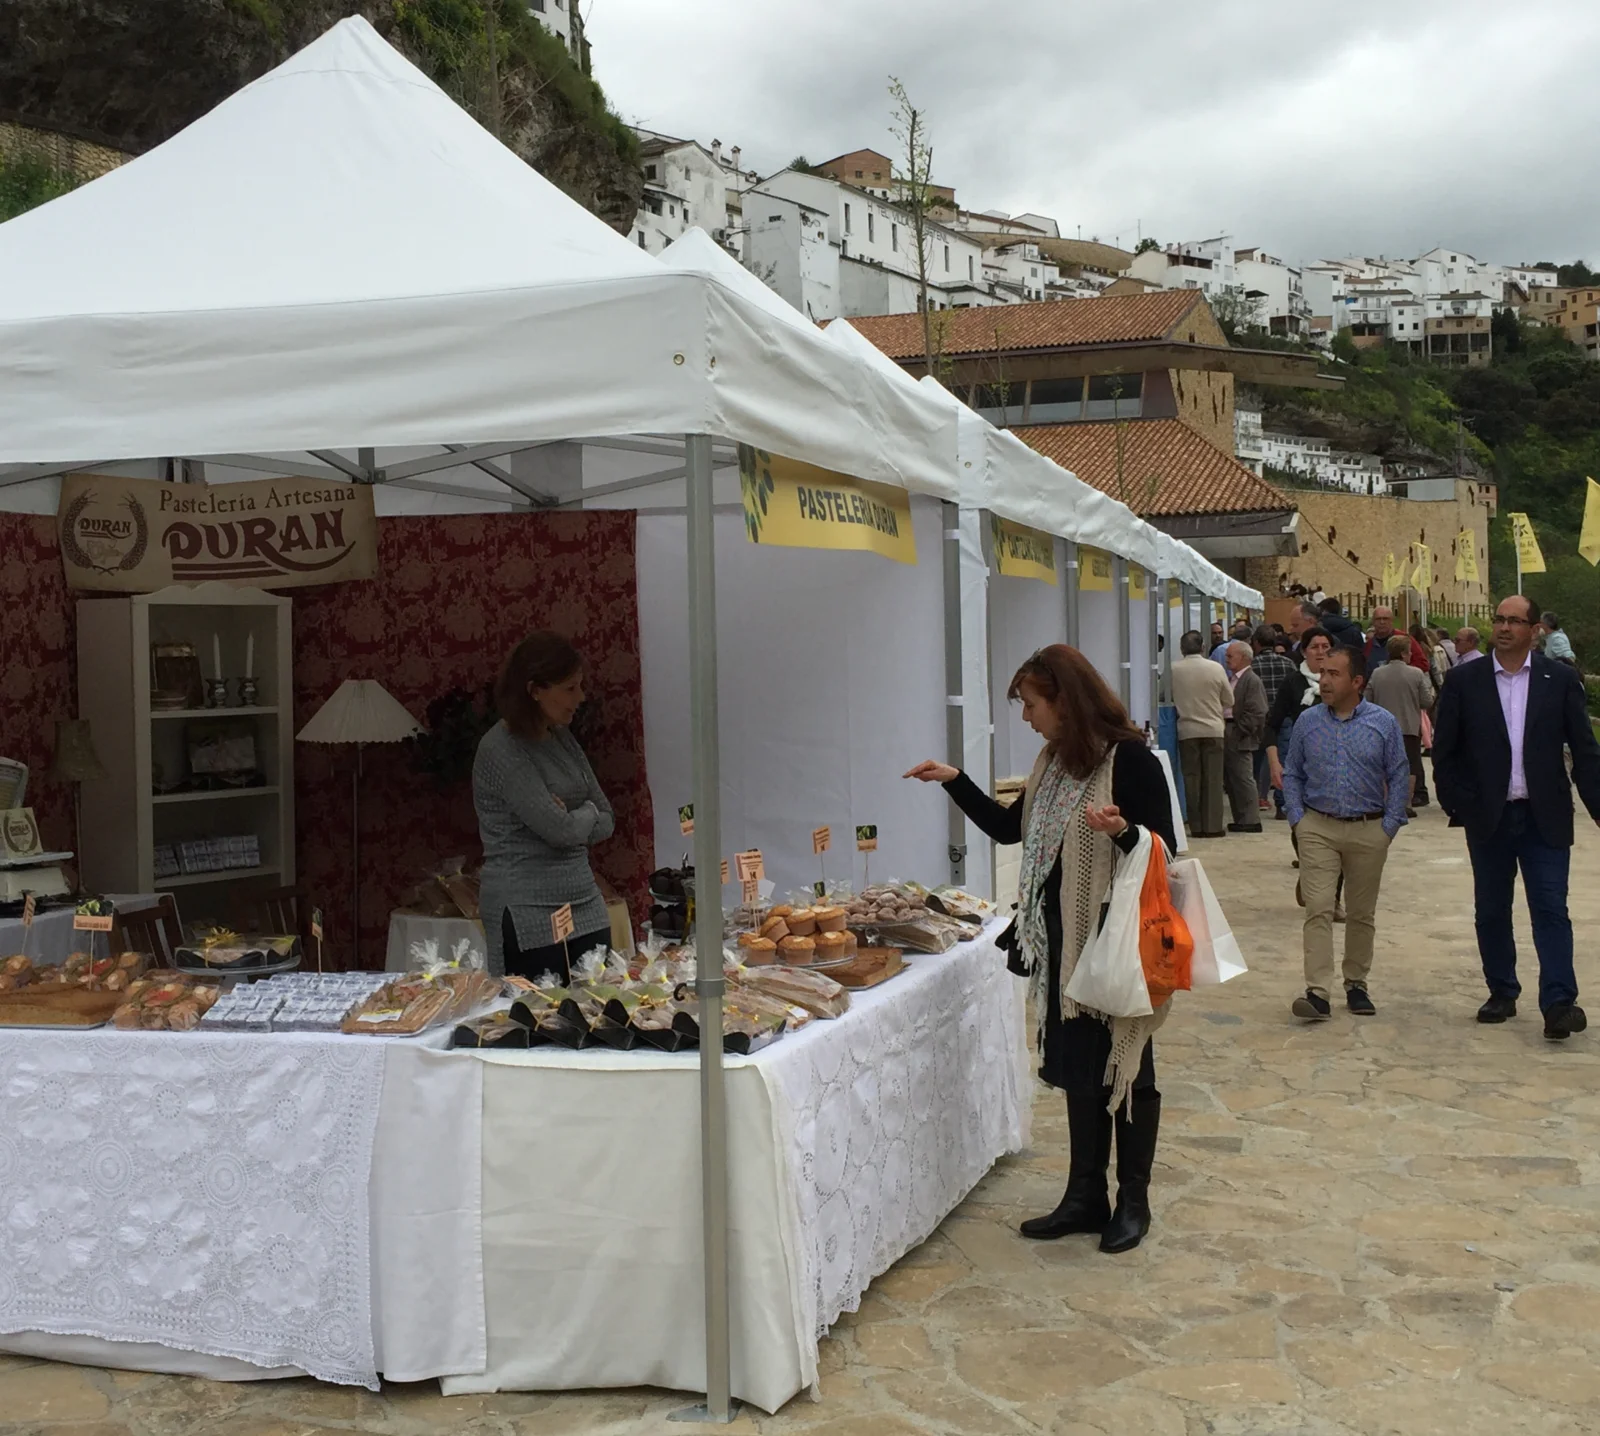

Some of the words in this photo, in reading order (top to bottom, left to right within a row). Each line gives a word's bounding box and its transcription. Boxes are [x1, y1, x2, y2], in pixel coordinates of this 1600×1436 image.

[159, 489, 257, 514] Pastelería
[264, 487, 356, 508] Artesana
[797, 486, 875, 527] PASTELERIA
[77, 517, 134, 540] DURAN
[161, 508, 356, 571] DURAN
